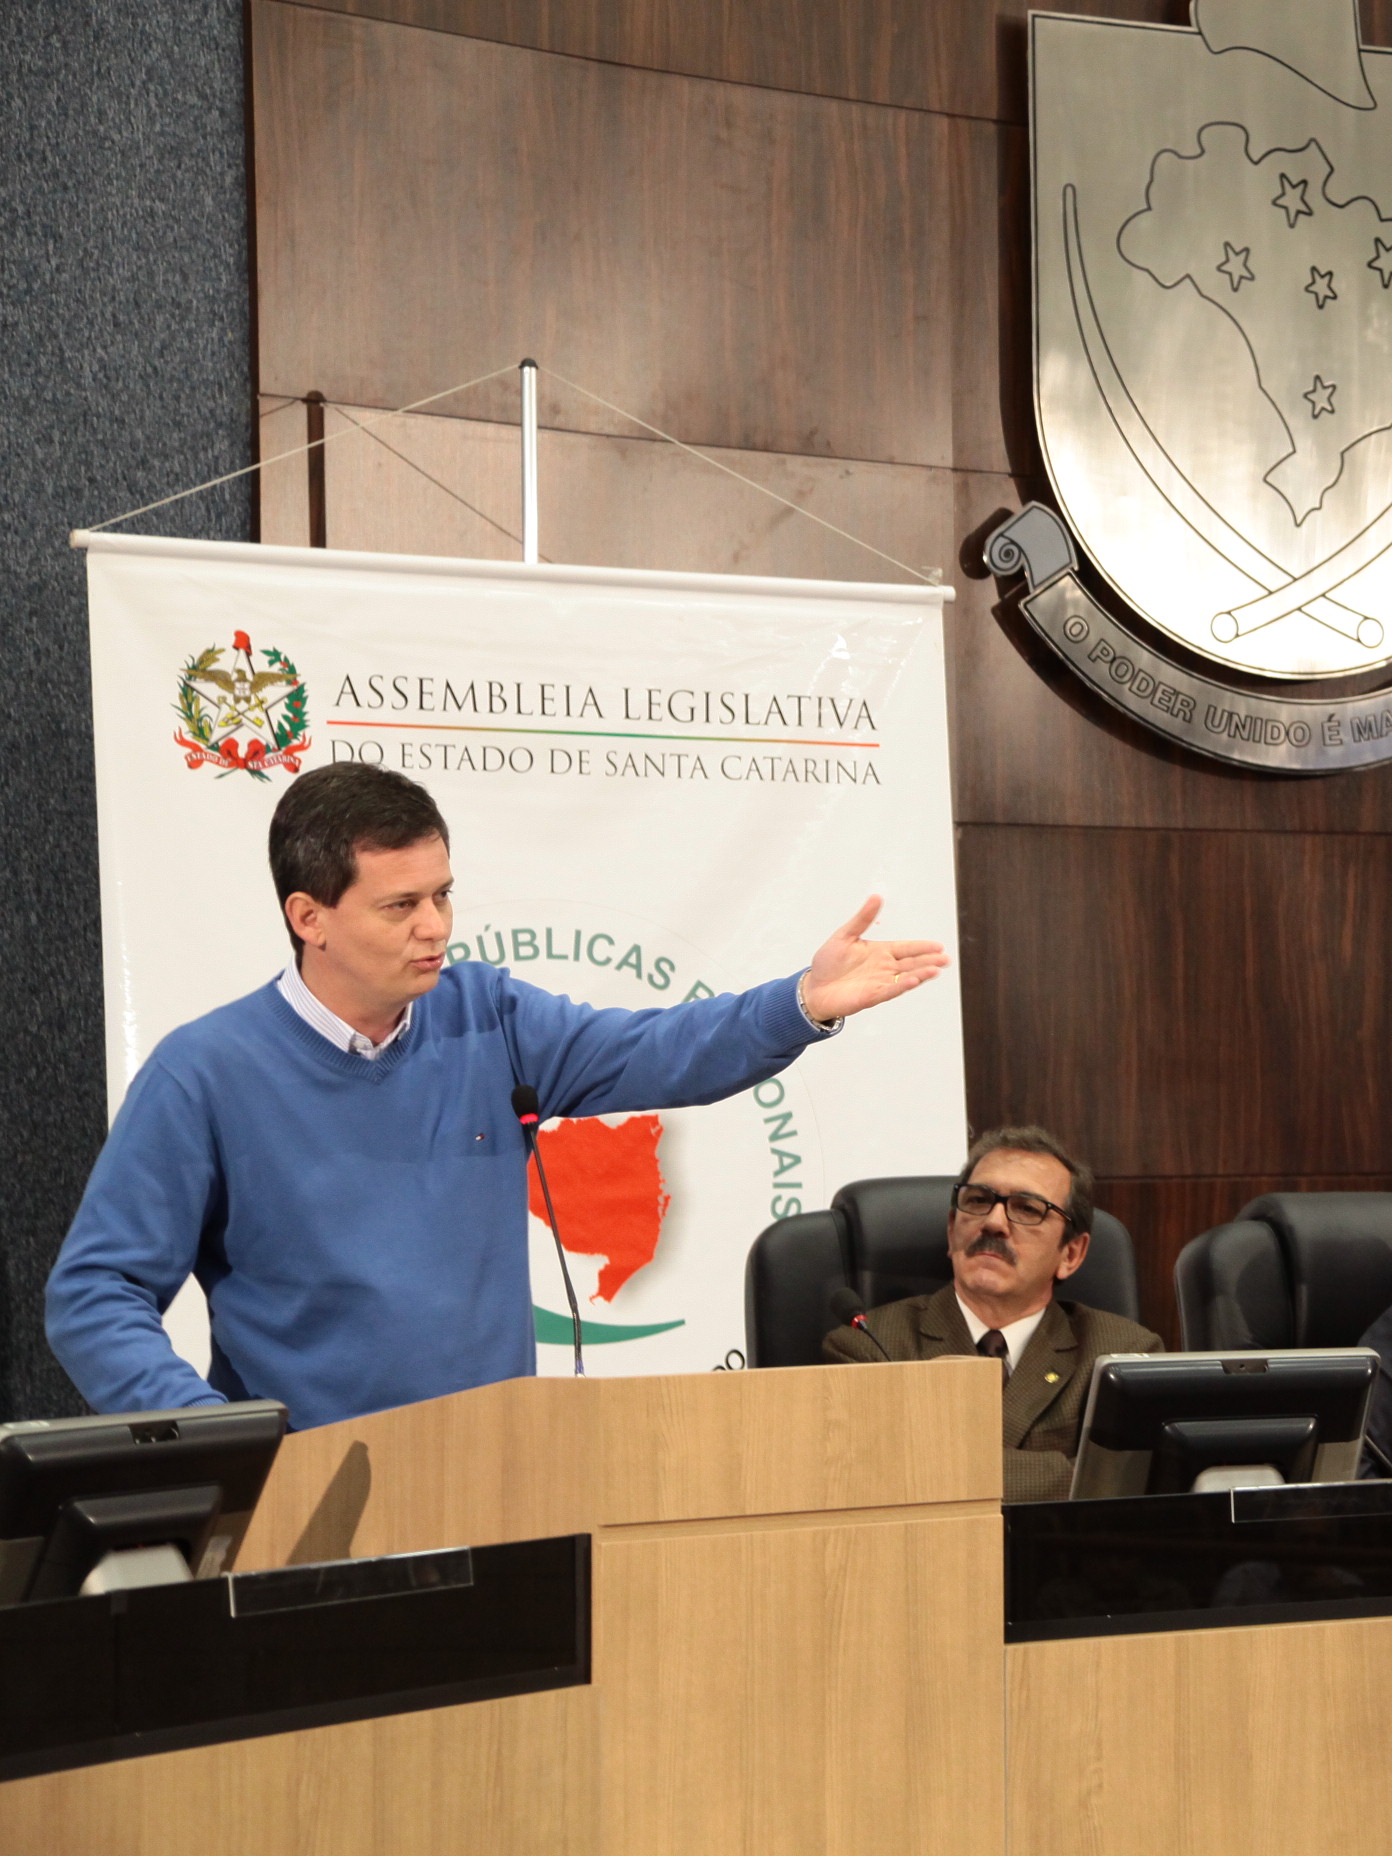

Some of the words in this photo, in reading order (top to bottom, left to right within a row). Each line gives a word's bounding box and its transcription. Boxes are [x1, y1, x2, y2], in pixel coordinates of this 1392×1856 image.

[334, 674, 605, 719] ASSEMBLEIA
[623, 687, 878, 730] LEGISLATIVA
[1063, 615, 1089, 643] O
[1088, 639, 1196, 723] PODER
[1204, 704, 1311, 748] UNIDO
[1321, 712, 1343, 747] É
[400, 742, 534, 774] ESTADO
[549, 748, 591, 775] DE
[605, 751, 710, 780] SANTA
[720, 755, 881, 785] CATARINA
[446, 923, 676, 991] PÚBLICAS
